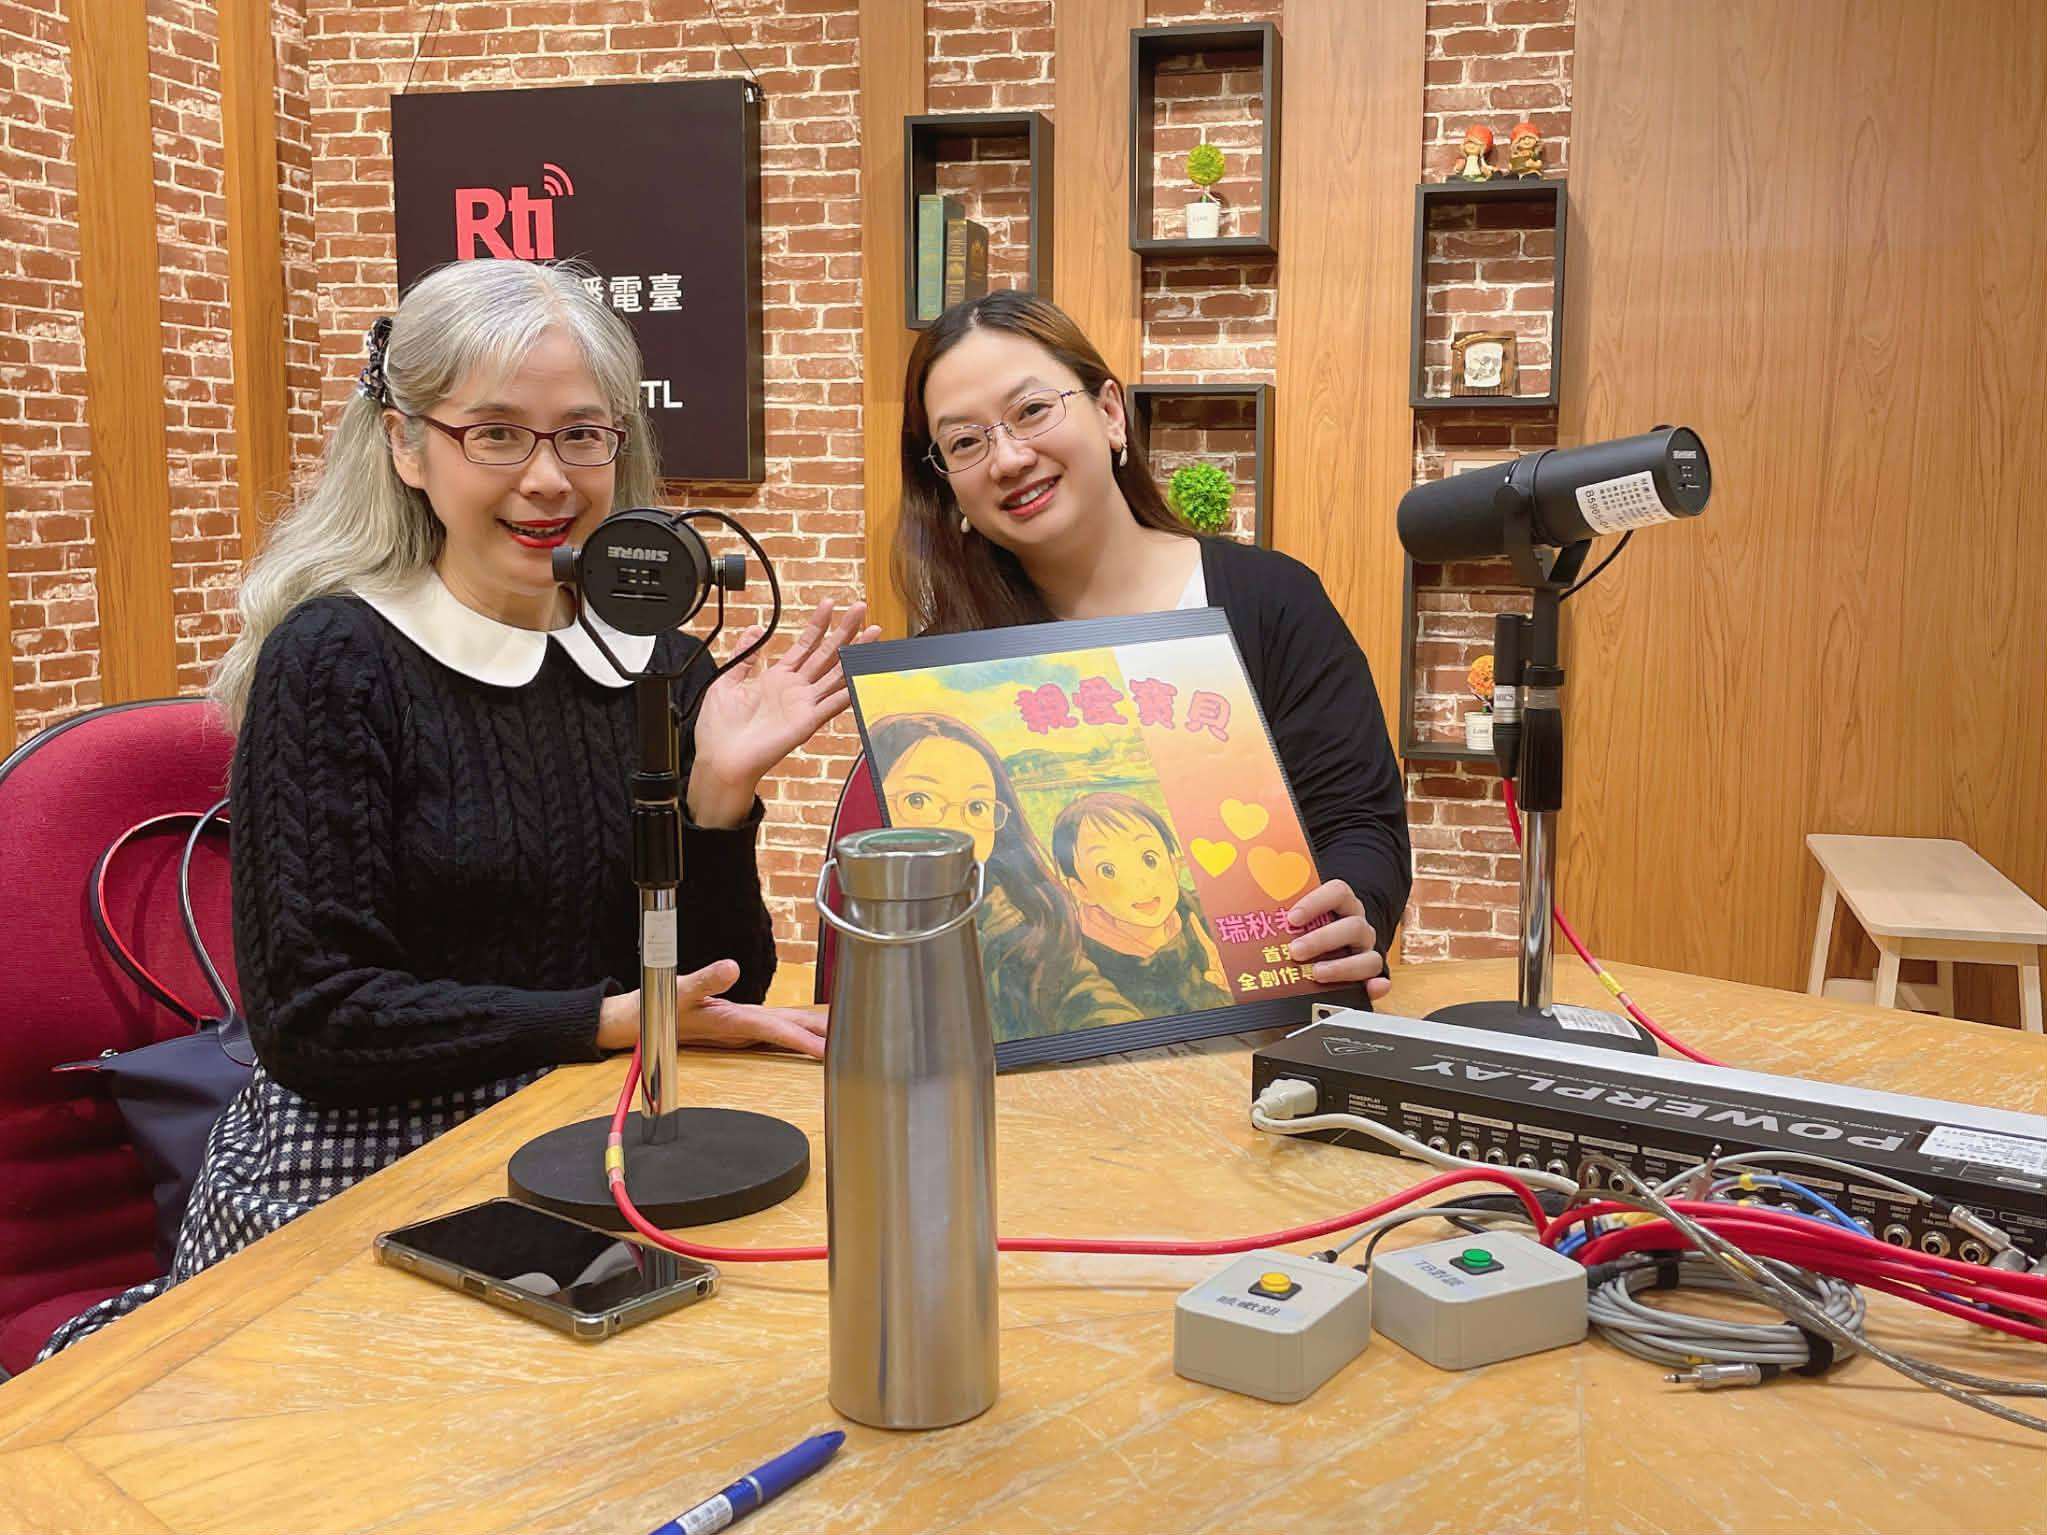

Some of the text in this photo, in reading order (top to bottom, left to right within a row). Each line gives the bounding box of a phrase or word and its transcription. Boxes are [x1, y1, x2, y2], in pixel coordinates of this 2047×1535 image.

[455, 186, 556, 261] Rti
[638, 380, 684, 409] TL
[607, 546, 670, 562] SHURE
[1411, 1066, 1905, 1151] POWERPLAY
